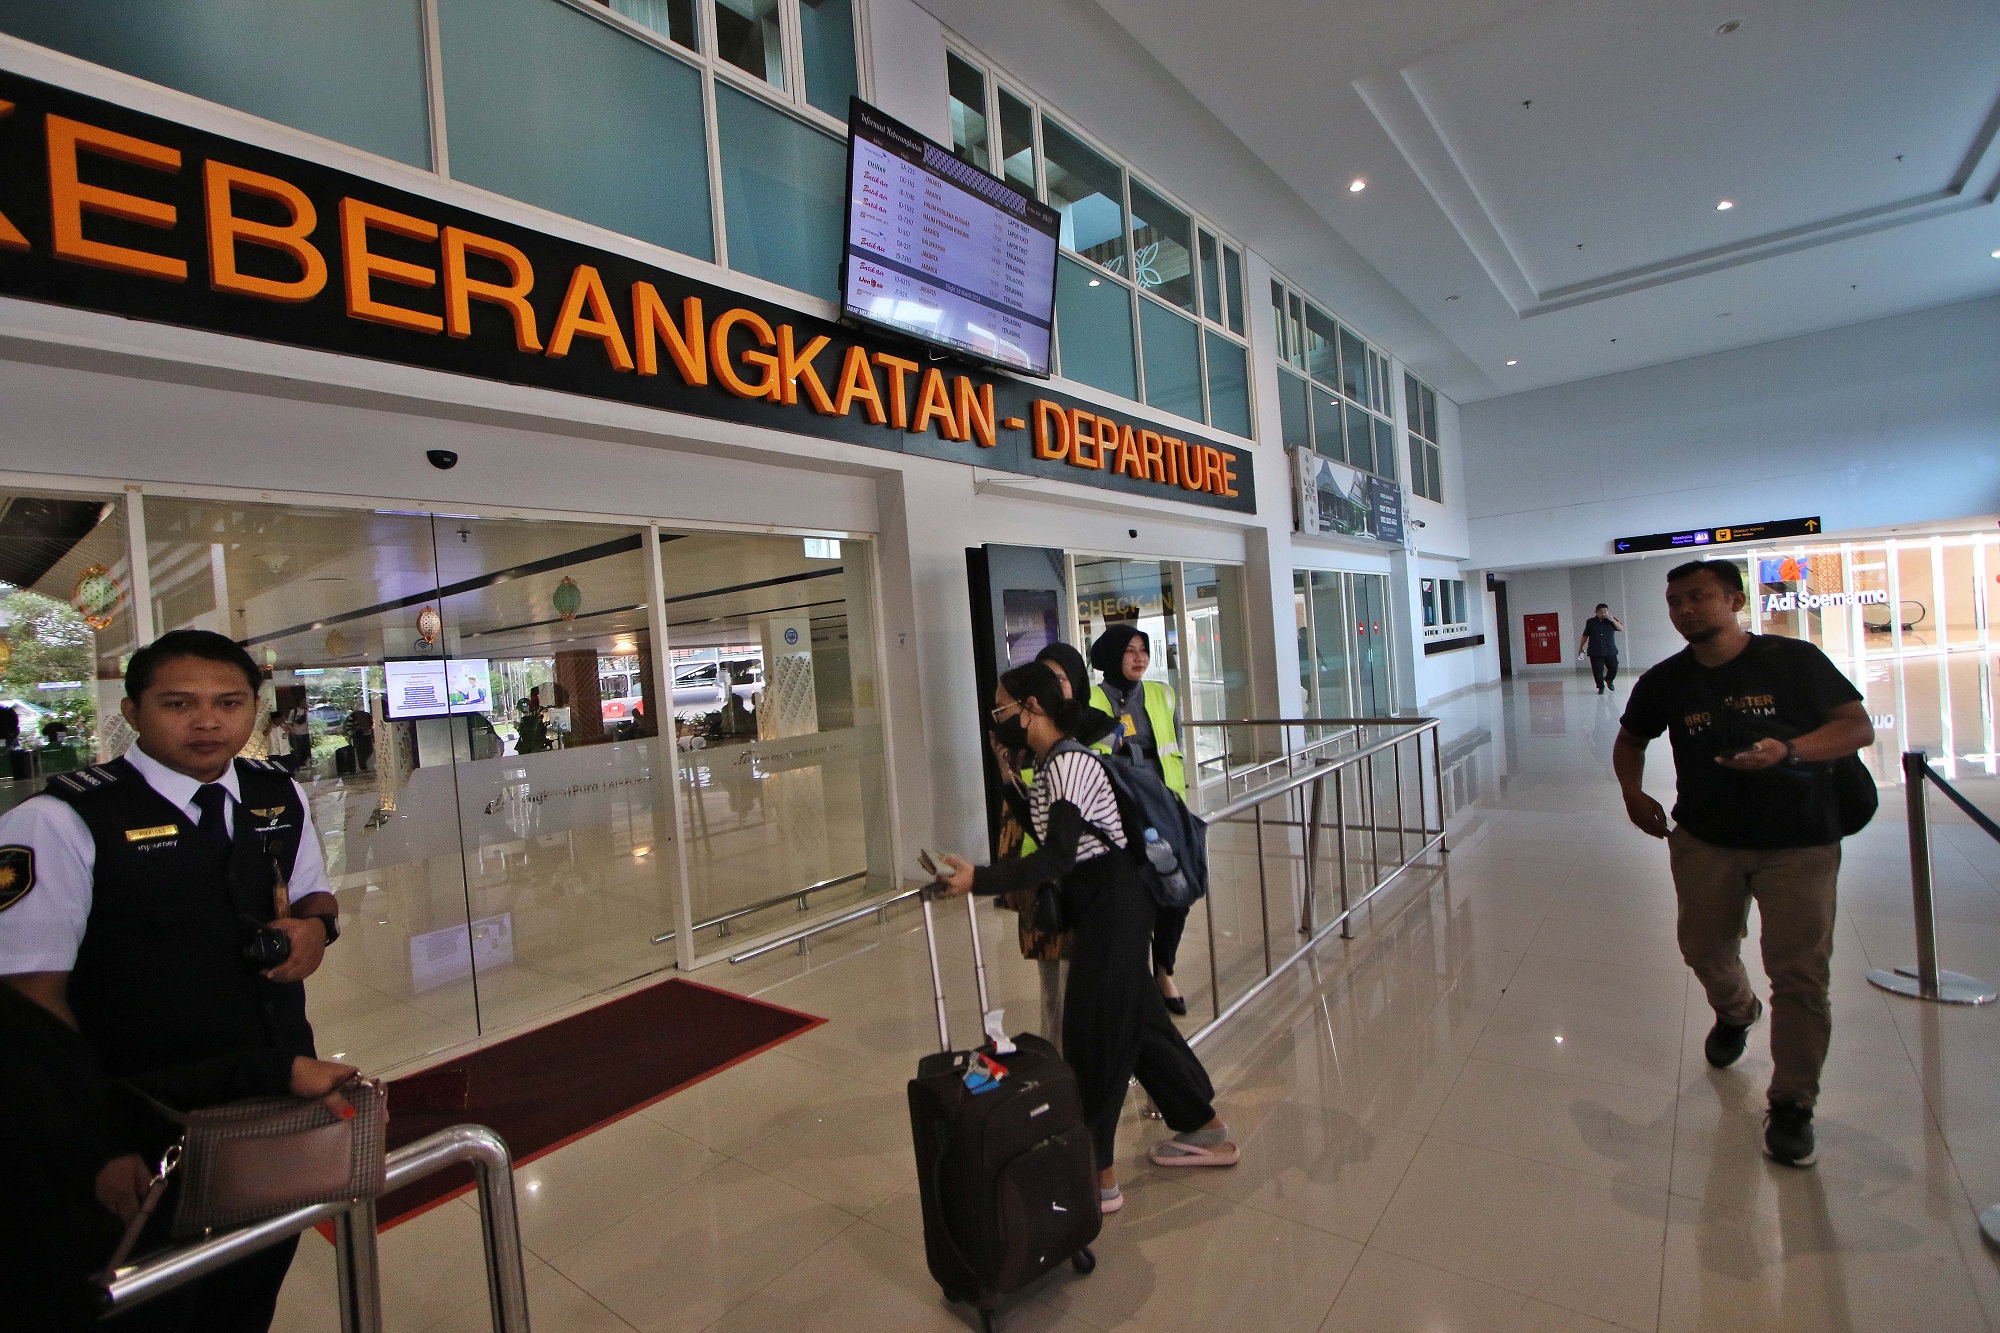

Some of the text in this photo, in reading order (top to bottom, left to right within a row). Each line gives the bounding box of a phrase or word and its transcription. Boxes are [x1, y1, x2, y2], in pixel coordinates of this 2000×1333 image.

[1034, 398, 1238, 497] DEPARTURE
[1766, 588, 1888, 612] Adi Soemarmo
